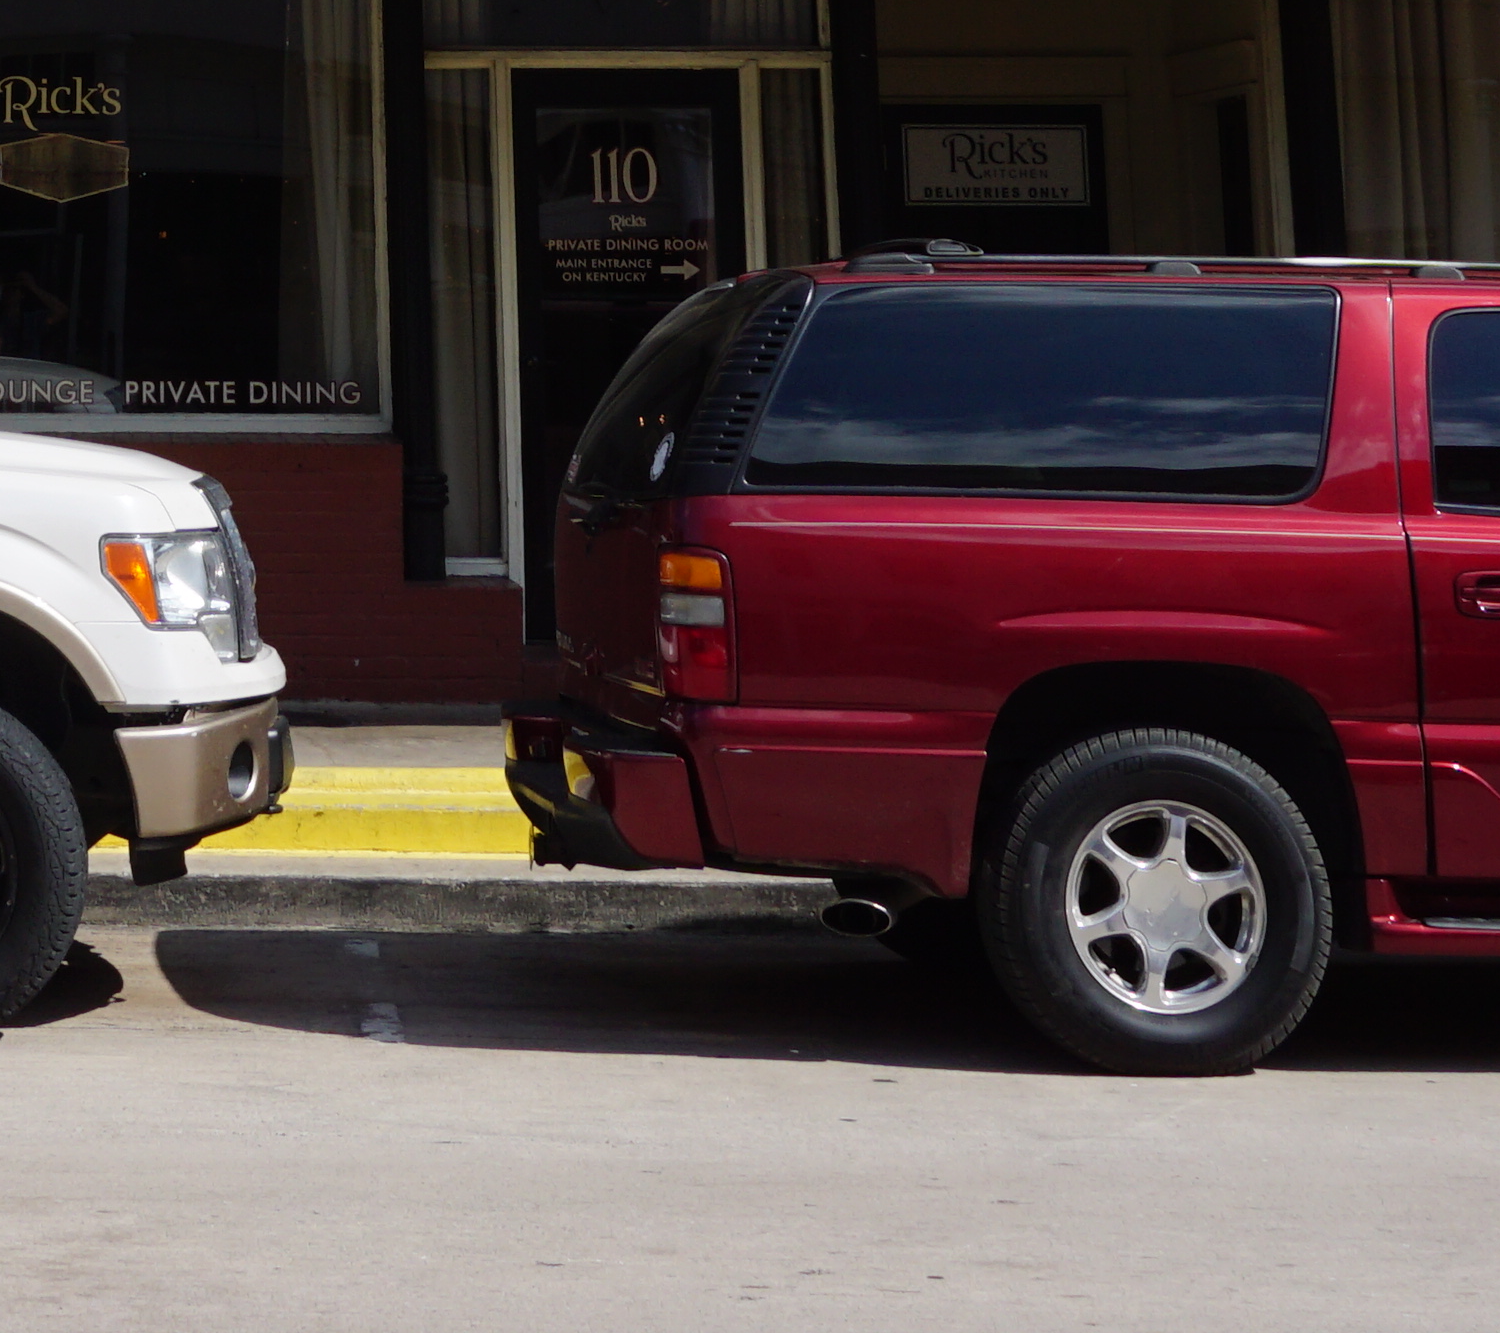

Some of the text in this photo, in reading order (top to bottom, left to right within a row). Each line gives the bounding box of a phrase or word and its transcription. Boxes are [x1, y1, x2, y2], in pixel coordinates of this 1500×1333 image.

[942, 133, 1048, 180] Rick's
[590, 147, 657, 203] 110
[983, 169, 1048, 179] KITCHEN
[924, 187, 1070, 199] DELIVERIES ONLY
[609, 214, 647, 231] Rick's
[548, 239, 709, 251] PRIVATE DINING ROOM
[556, 259, 653, 269] MAIN ENTRANCE
[562, 272, 647, 282] ON KENTUCKY
[124, 380, 237, 405] PRIVATE
[249, 381, 362, 406] DINING
